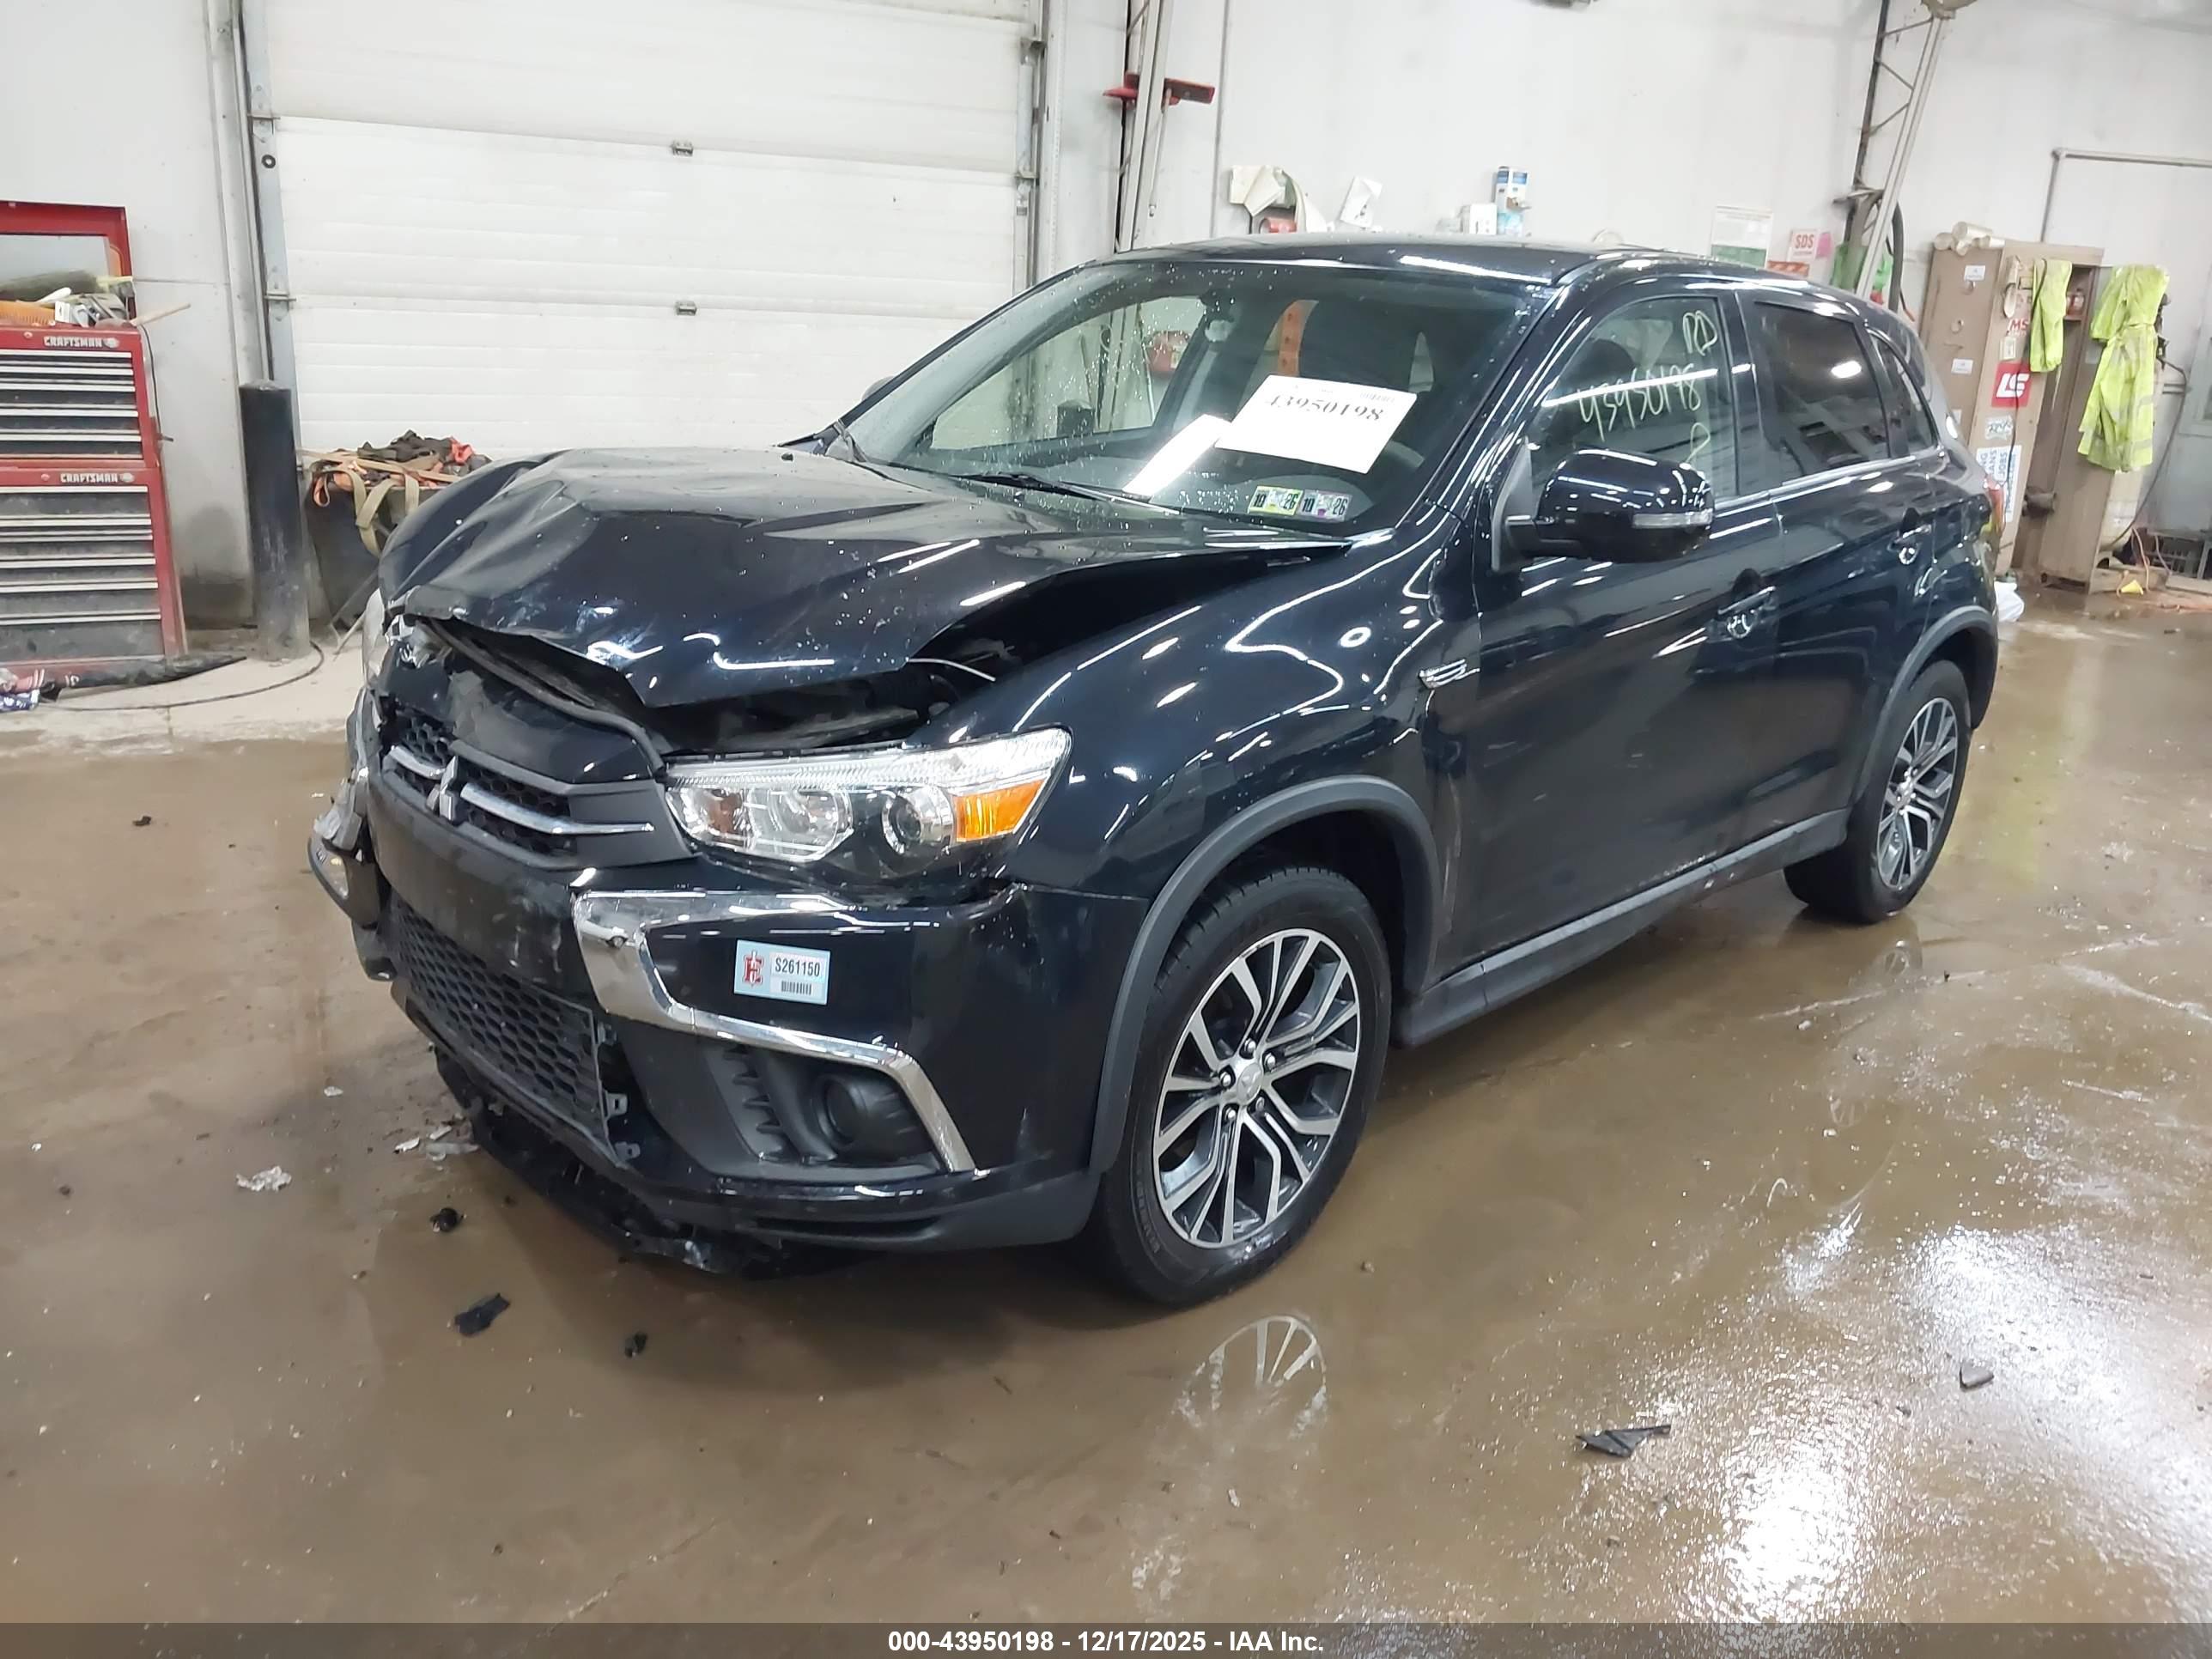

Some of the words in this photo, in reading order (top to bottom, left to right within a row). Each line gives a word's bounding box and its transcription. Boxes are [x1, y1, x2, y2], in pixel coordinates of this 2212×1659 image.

[1795, 234, 1814, 249] SDS
[44, 336, 103, 348] CRAFTSMAN
[60, 473, 118, 483] CRAFTSMAN
[1253, 494, 1267, 508] 10
[1283, 493, 1298, 509] 26
[1302, 497, 1316, 513] 10
[1332, 497, 1348, 515] 26
[775, 957, 821, 977] S261150
